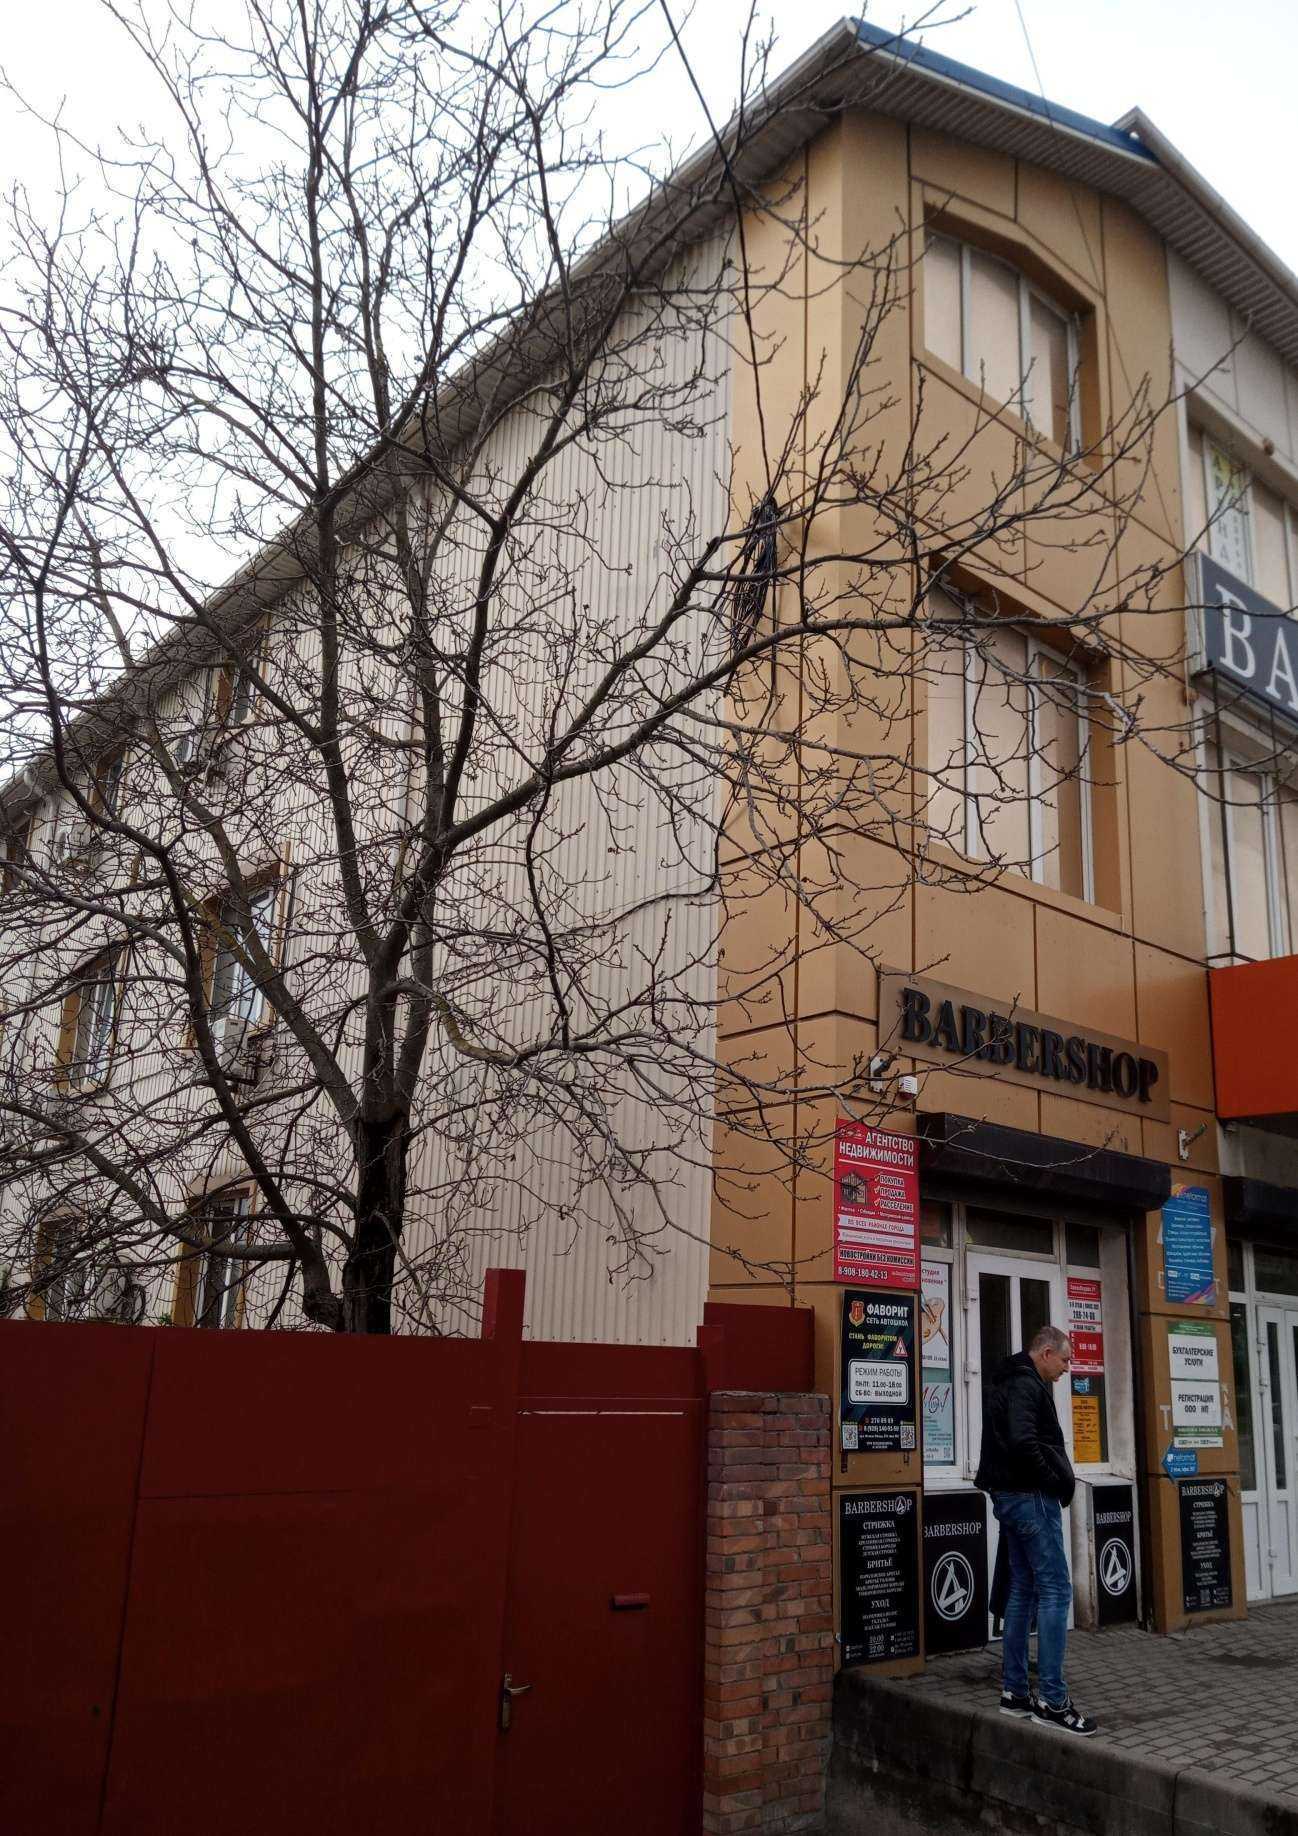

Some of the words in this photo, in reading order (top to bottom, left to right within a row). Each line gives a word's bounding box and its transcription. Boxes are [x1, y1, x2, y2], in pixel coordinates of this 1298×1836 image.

[901, 987, 1159, 1102] BARBERSHOP
[865, 1131, 914, 1152] АГЕНТСТВО
[839, 1141, 914, 1167] НЕДВИЖИМОСТИ
[866, 1303, 909, 1318] ФАВОРИТ
[866, 1317, 880, 1325] СЕТЬ
[1172, 1346, 1214, 1357] БУХГАЛТЕРСКИЕ
[1184, 1357, 1204, 1367] УСЛУГИ
[1178, 1393, 1214, 1404] РЕГИСТРАЦИЯ
[1096, 1511, 1131, 1525] BARBERSHOP
[863, 1520, 895, 1530] СТРИЖКА
[871, 1599, 890, 1609] УХОД
